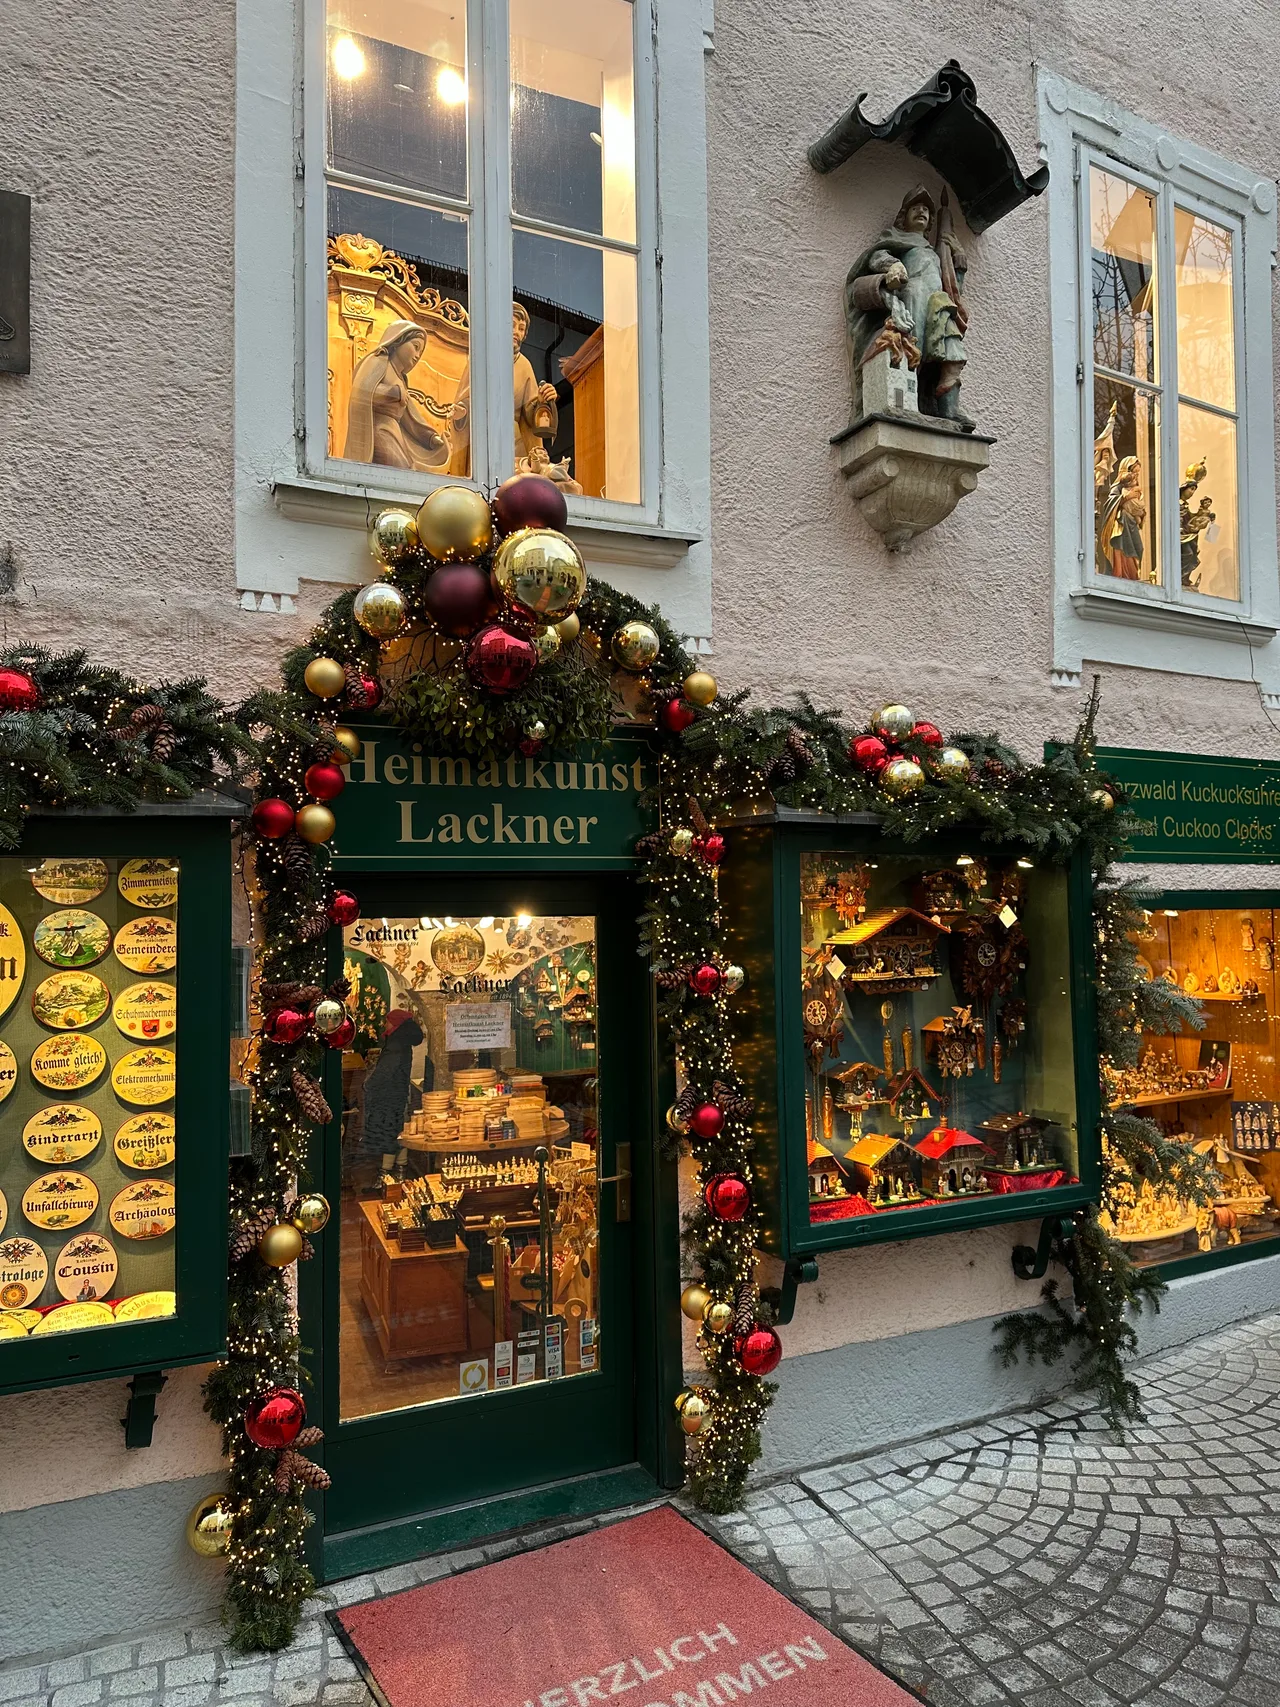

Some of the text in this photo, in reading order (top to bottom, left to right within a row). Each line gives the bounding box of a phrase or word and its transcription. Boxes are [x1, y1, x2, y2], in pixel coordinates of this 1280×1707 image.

[339, 740, 647, 792] Heimatkunst
[396, 800, 598, 845] Lackner
[1163, 816, 1220, 839] Cuckoo
[1225, 818, 1272, 841] Clocks
[349, 925, 418, 945] Lackner
[438, 975, 511, 994] Lackner
[34, 1051, 103, 1071] Komme gleich!
[27, 1130, 99, 1148] Kinderarzt
[26, 1198, 94, 1213] Unfallchirurg
[0, 1268, 44, 1282] trologe
[58, 1261, 114, 1278] Cousin
[523, 1621, 738, 1707] ERZLICH
